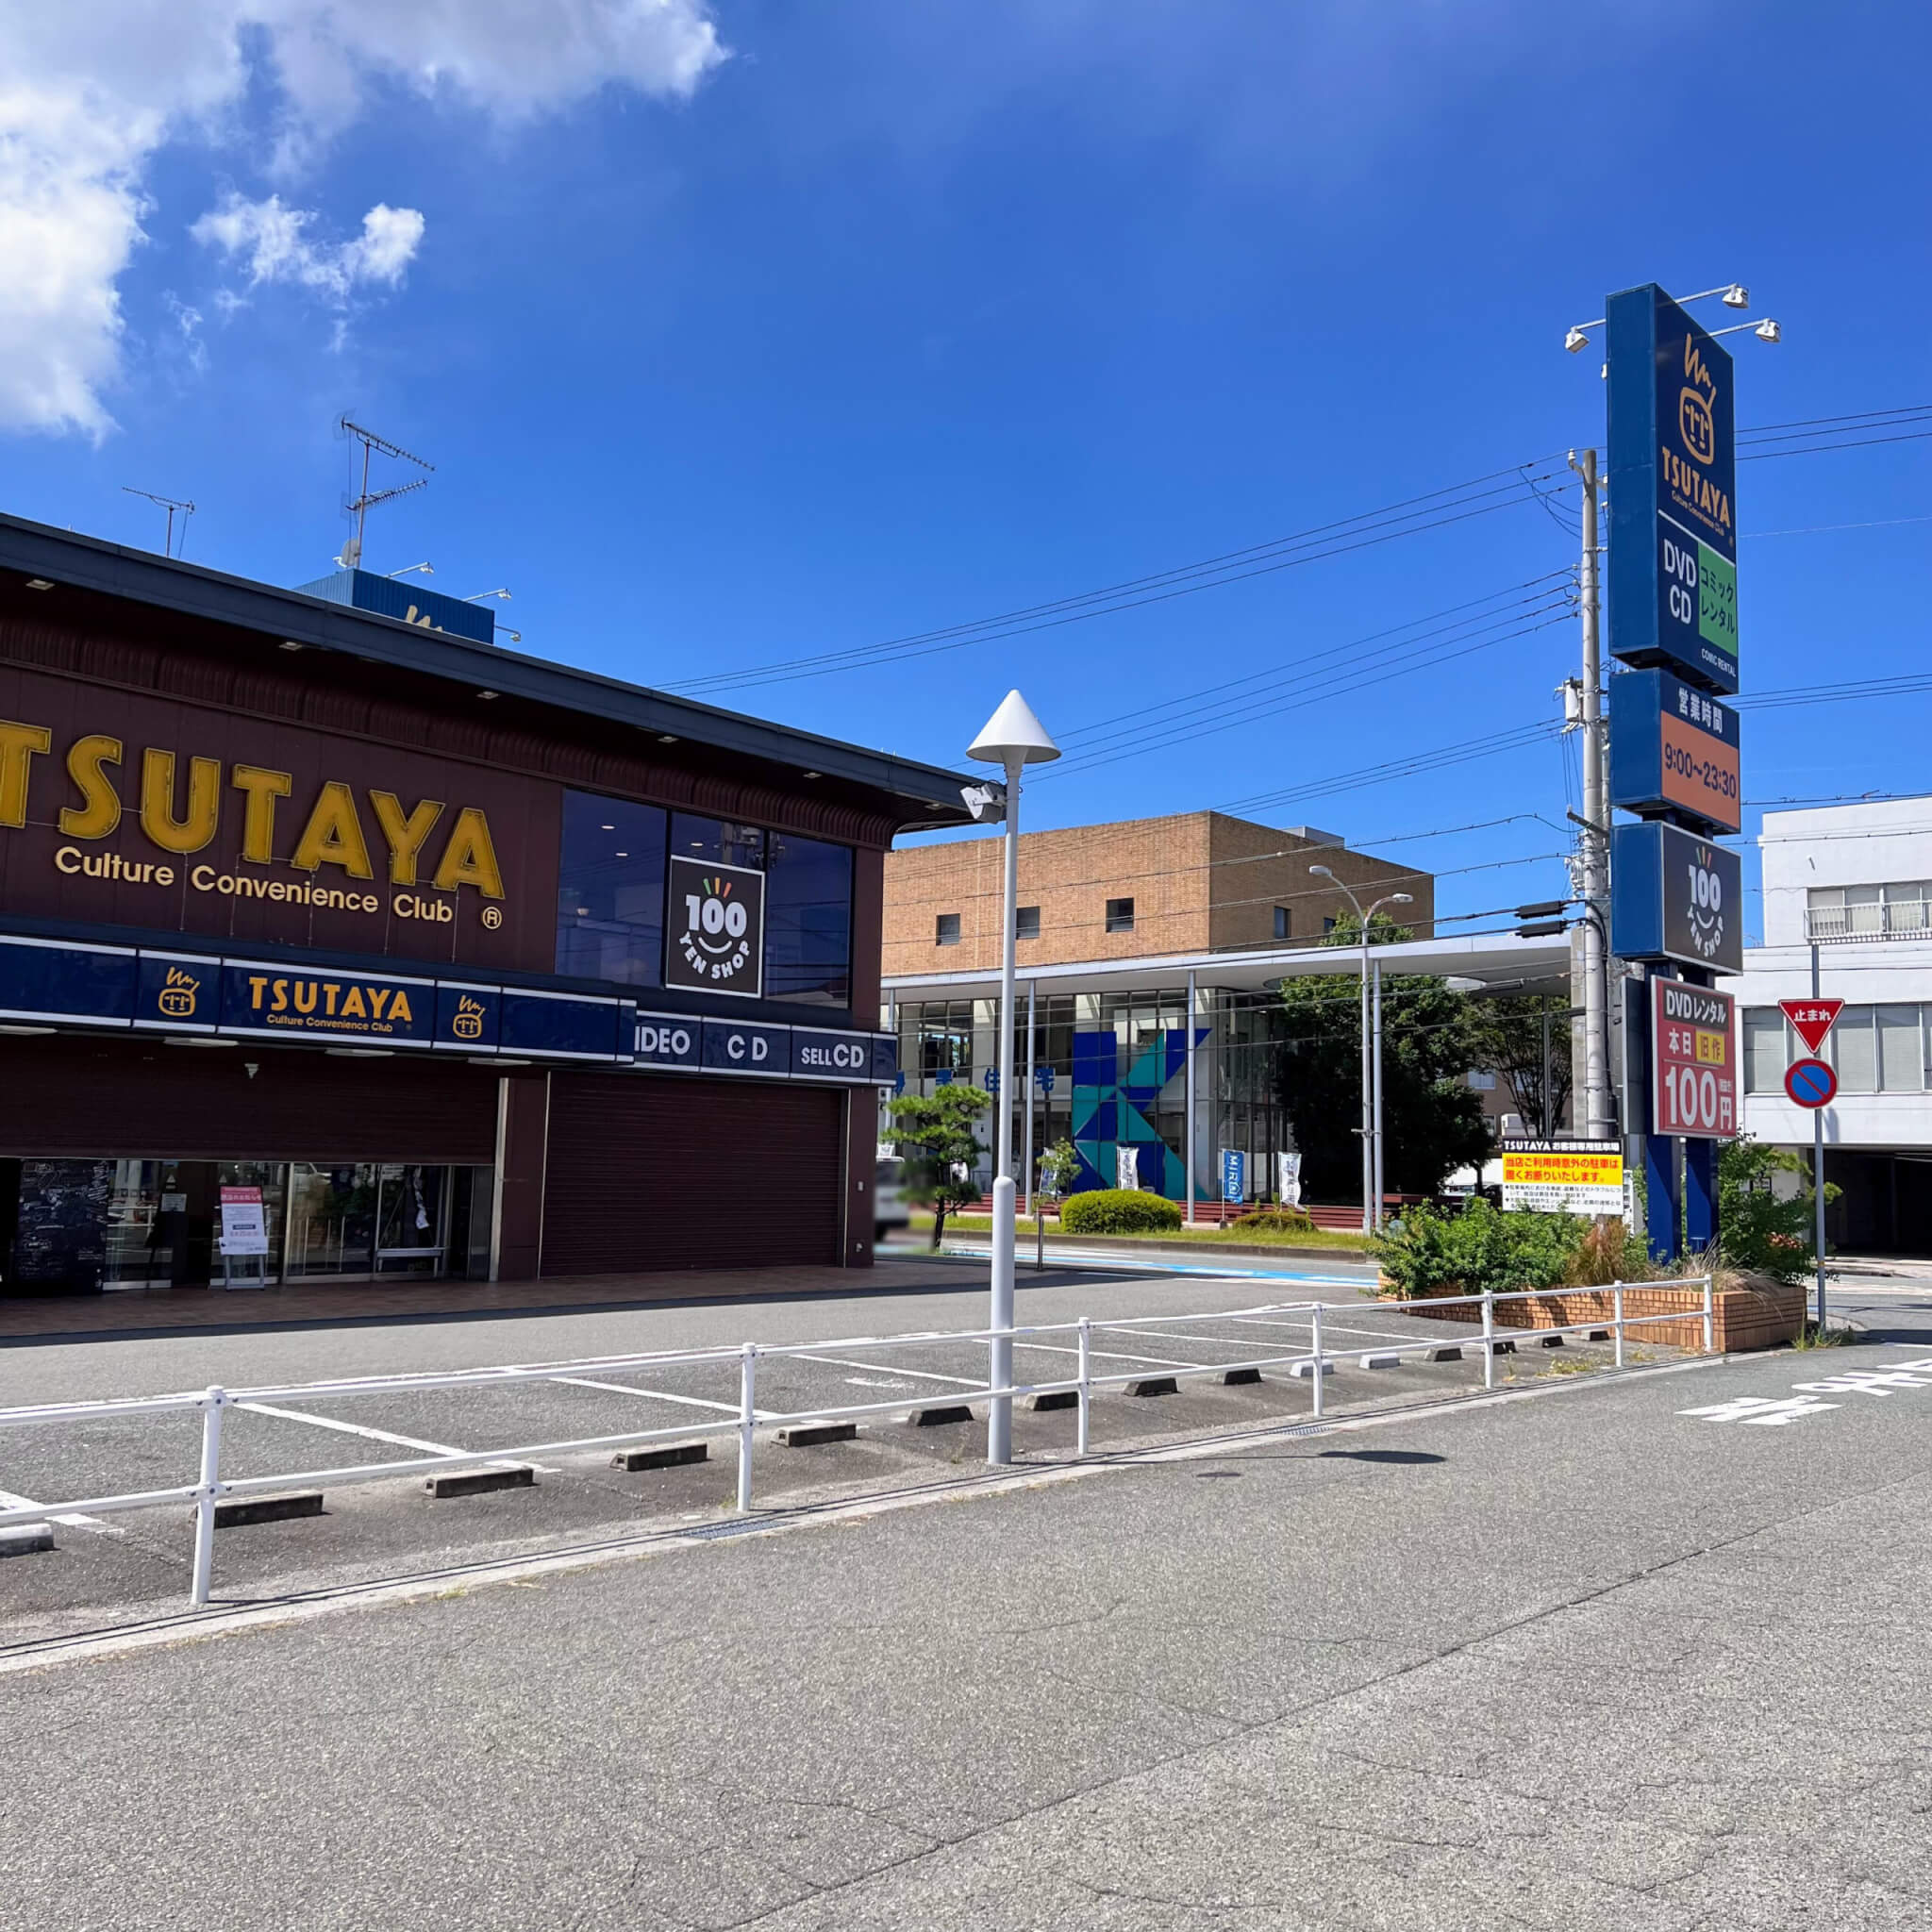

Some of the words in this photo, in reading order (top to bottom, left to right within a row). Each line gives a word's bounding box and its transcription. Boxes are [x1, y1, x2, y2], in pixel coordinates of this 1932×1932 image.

[1661, 445, 1731, 528] TSUTAYA
[1664, 539, 1697, 589] DVD
[1701, 566, 1734, 604] コミック
[1670, 584, 1691, 625] CD
[1701, 600, 1736, 635] レンタル
[1717, 658, 1737, 678] RENTAL
[1678, 687, 1723, 735] 営業時間
[0, 720, 506, 900] TSUTAYA
[55, 845, 175, 887] Culture
[192, 864, 378, 913] Convenience
[392, 892, 454, 923] Club
[1688, 864, 1722, 912] 100
[686, 894, 747, 938] 100
[1687, 904, 1702, 950] YEN
[1704, 915, 1724, 958] SHOP
[679, 931, 707, 974] YEN
[710, 941, 751, 980] SHOP
[248, 975, 412, 1023] TSUTAYA
[1665, 990, 1725, 1024] DVDレンタル
[1793, 1009, 1832, 1022] 止まれ
[266, 1013, 304, 1026] Culture
[306, 1016, 369, 1030] Convenience
[371, 1023, 392, 1033] Club
[1669, 1027, 1691, 1056] 本日
[1700, 1035, 1722, 1060] 旧作
[1505, 1141, 1551, 1151] TSUTAYA
